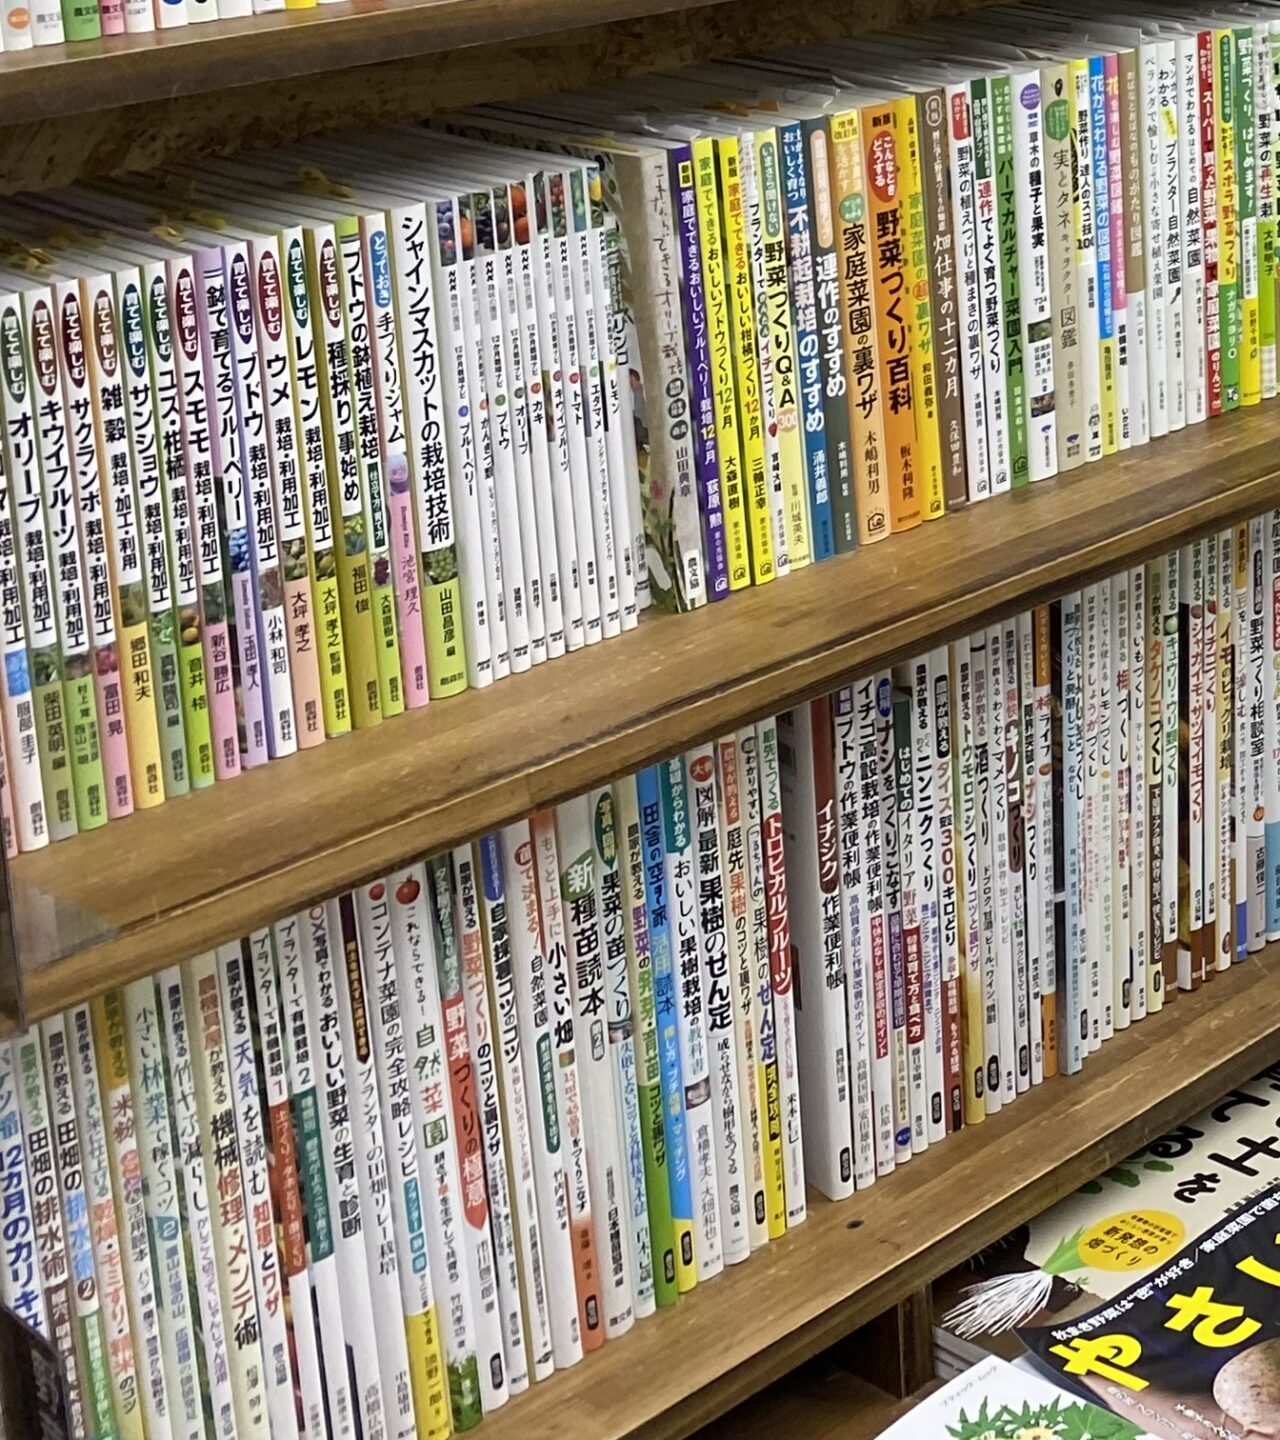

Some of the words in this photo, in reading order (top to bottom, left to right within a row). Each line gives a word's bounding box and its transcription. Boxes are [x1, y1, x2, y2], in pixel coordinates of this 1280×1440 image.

[815, 254, 847, 397] 連作のすすめ
[843, 223, 878, 419] 家庭菜園の裏ワザ
[933, 232, 959, 400] 畑仕事の十二カ月
[999, 158, 1023, 377] パーマカルチャー菜園入門
[101, 383, 126, 444] 雑穀
[184, 370, 210, 455] スモモ
[296, 336, 320, 423] レモン
[401, 216, 451, 544] シャインマスカットの栽培技術
[572, 389, 583, 426] トマト
[8, 412, 41, 523] オリーブ
[40, 402, 75, 548] キウイフルーツ
[111, 453, 137, 570] 栽培・加工・利用
[193, 460, 219, 575] 栽培・利用加工
[305, 427, 331, 542] 栽培・利用加工
[699, 875, 734, 1031] 果樹のせん定
[765, 817, 792, 992] トロピカルフルーツ
[1101, 1224, 1159, 1256] 新発想の
